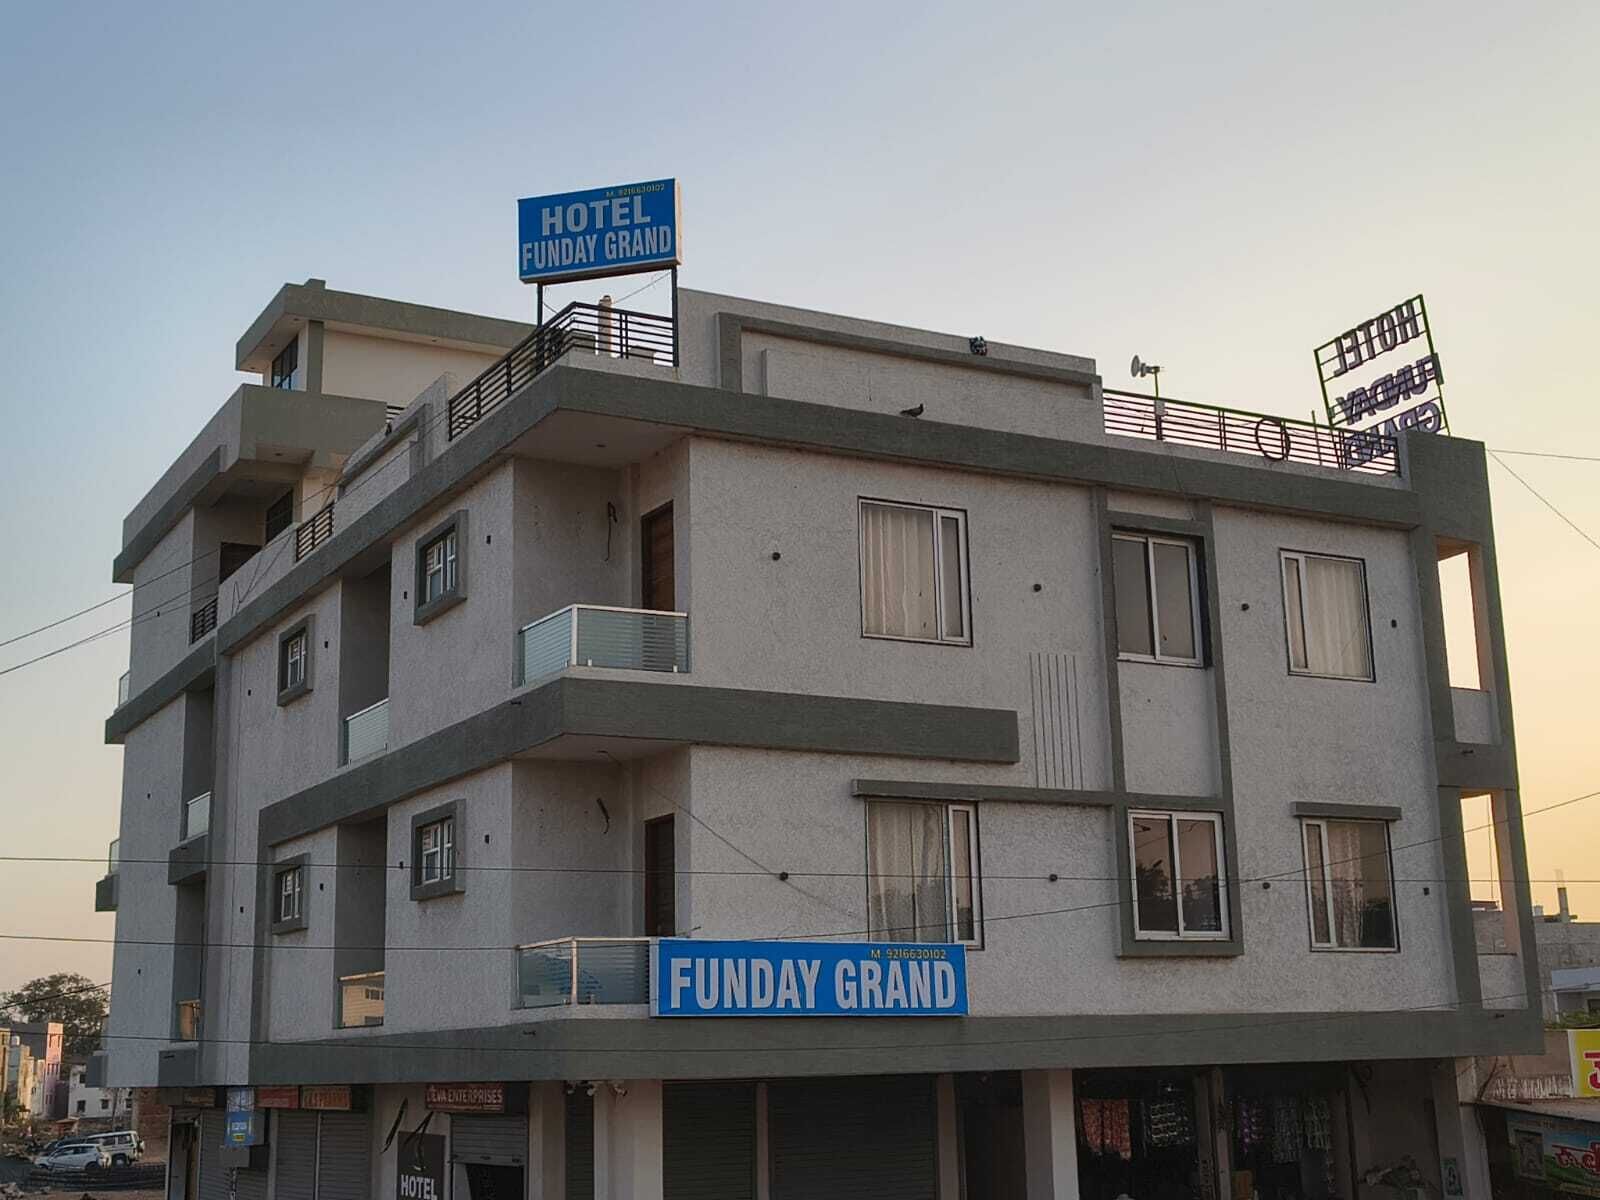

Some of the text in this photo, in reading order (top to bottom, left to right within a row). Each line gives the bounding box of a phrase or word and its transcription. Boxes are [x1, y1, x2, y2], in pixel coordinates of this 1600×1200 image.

[541, 195, 651, 236] HOTEL
[522, 225, 672, 271] FUNDAY GRAND
[886, 948, 946, 959] 9216630102
[670, 958, 956, 1010] FUNDAY GRAND
[448, 1088, 503, 1104] ENTERPRISES
[400, 1174, 438, 1200] HOTEL
